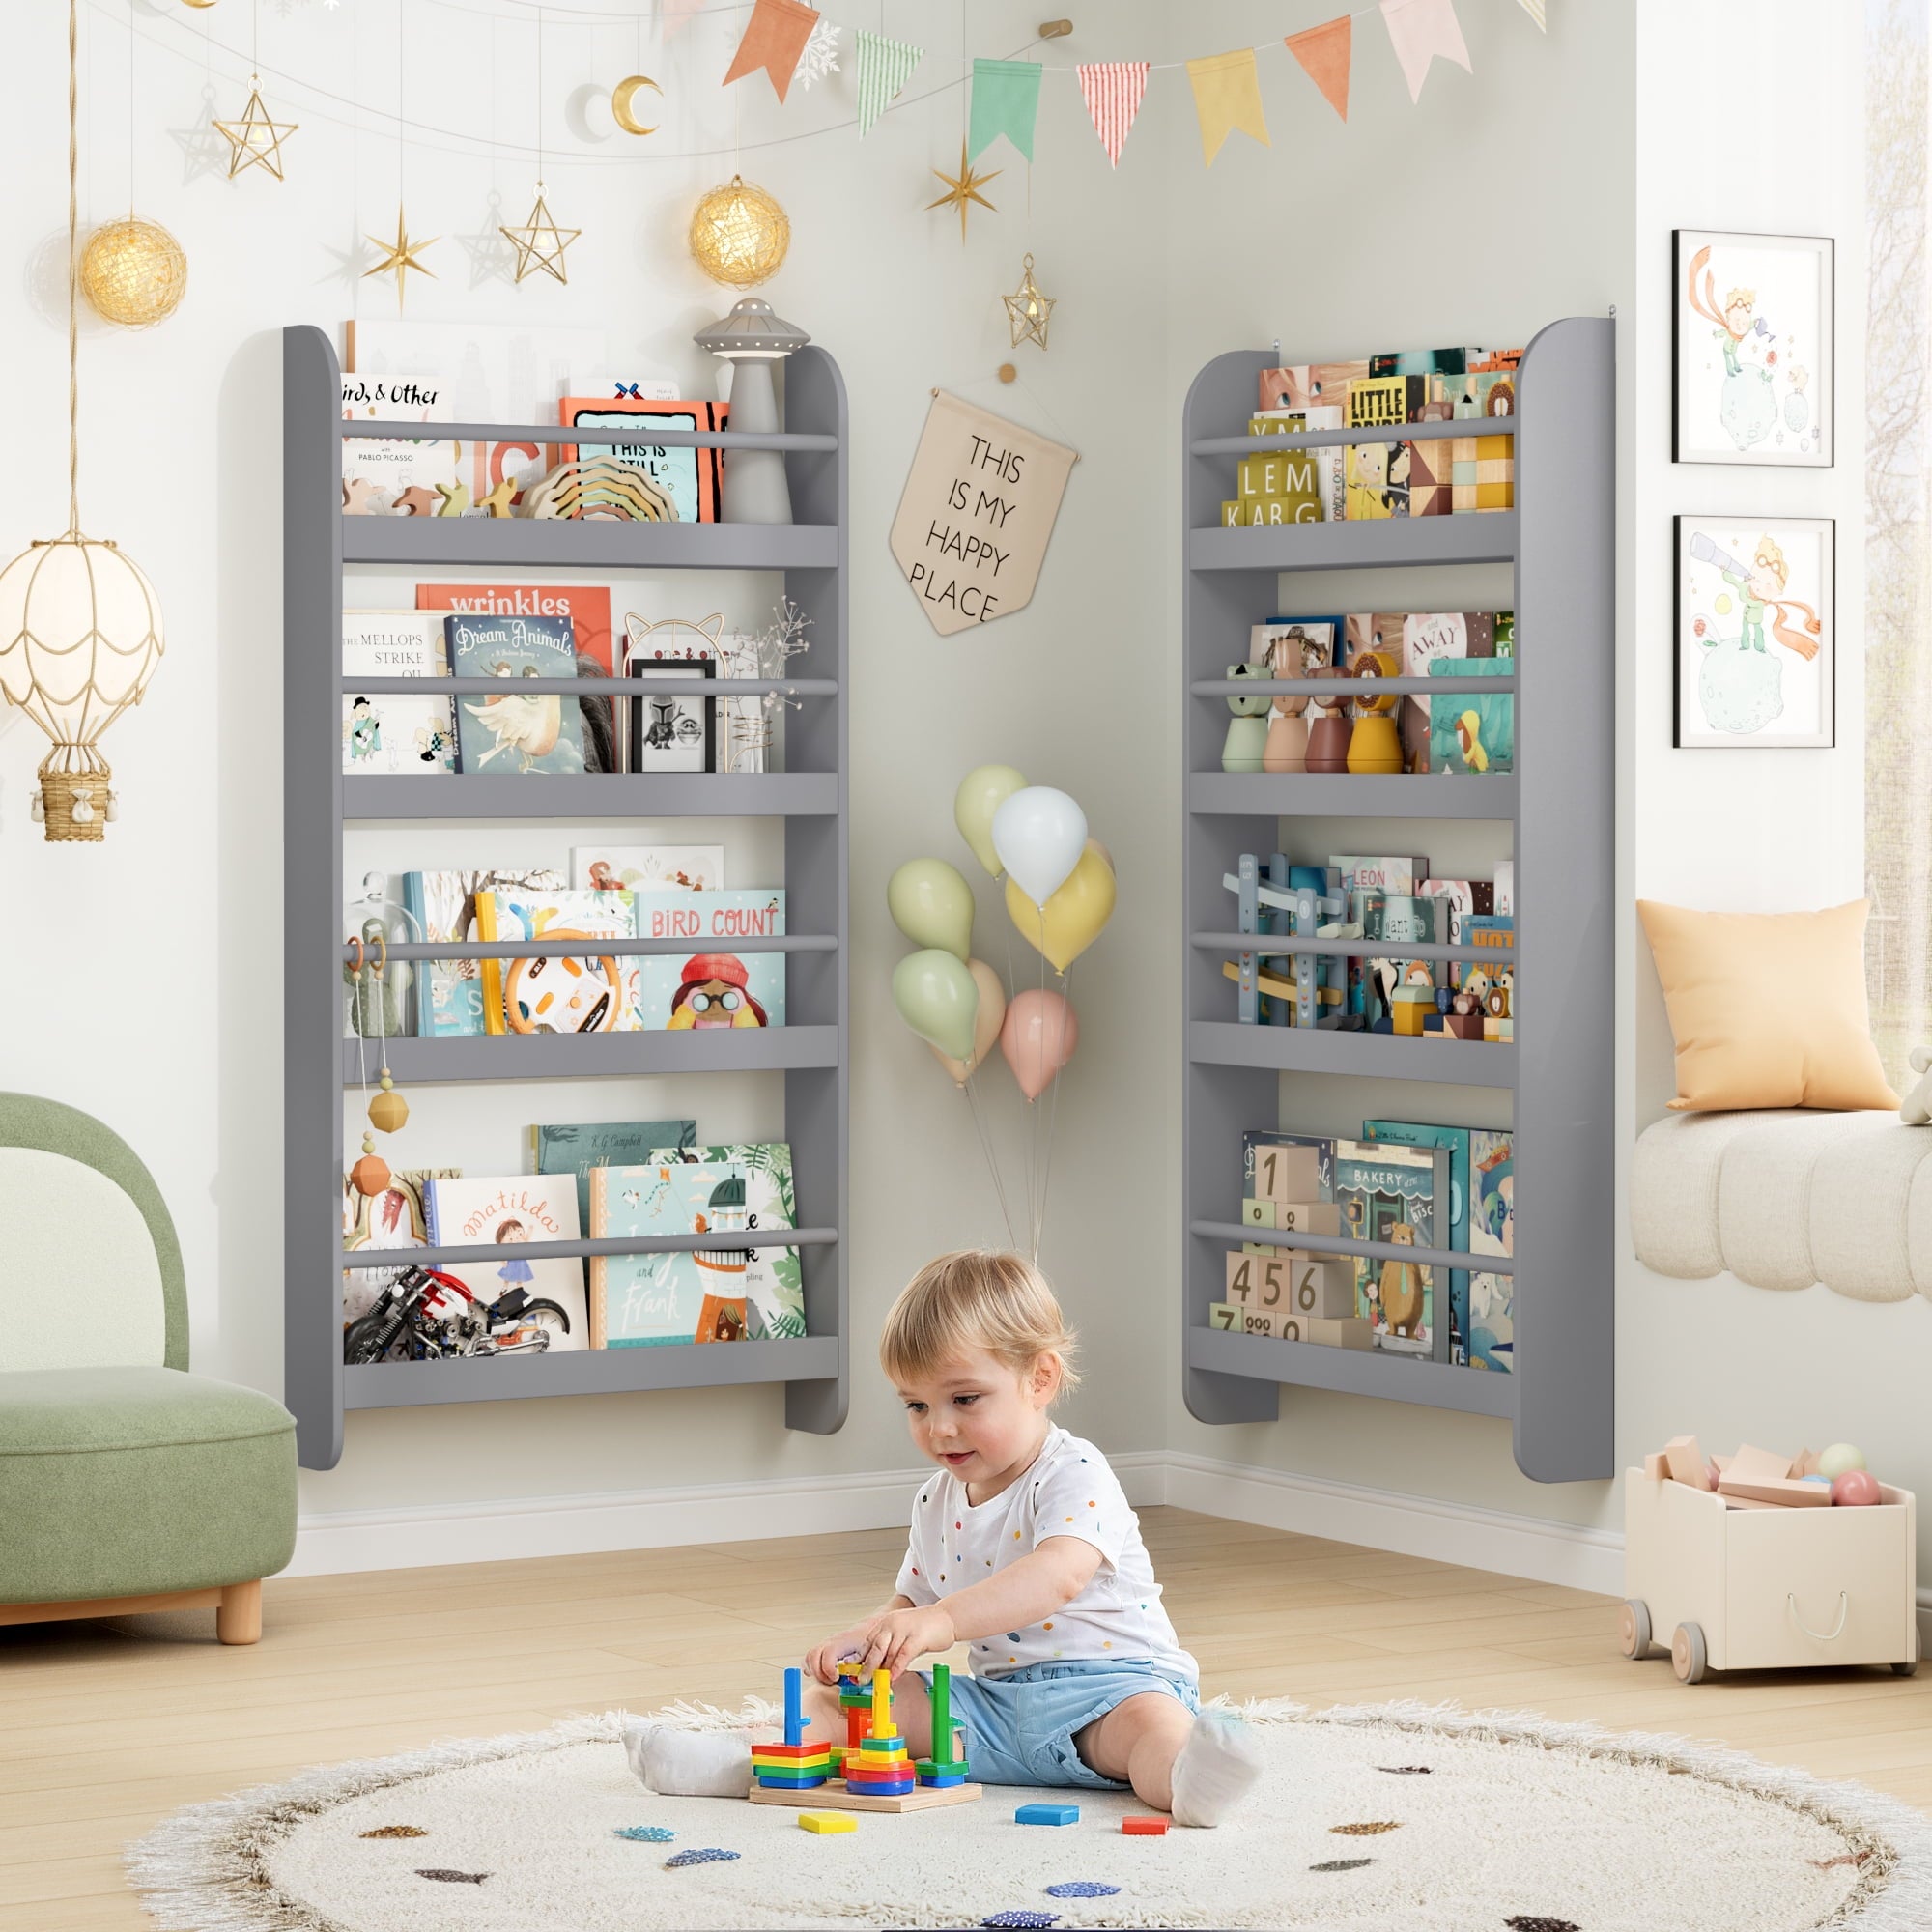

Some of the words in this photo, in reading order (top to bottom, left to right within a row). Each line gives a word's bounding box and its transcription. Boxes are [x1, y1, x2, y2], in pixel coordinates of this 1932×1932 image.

[342, 382, 371, 406] irds
[375, 384, 385, 401] &
[391, 384, 440, 406] Other
[1351, 388, 1403, 419] LITTLE
[971, 435, 1025, 484] THIS
[948, 478, 971, 510] IS
[975, 490, 1016, 528] MY
[925, 520, 1010, 577] HAPPY
[450, 589, 571, 616] wrinkles
[909, 562, 999, 622] PLACE
[360, 634, 423, 646] MELLOPS
[455, 623, 508, 656] Dream
[511, 619, 572, 657] Animals
[1412, 626, 1458, 661] AWAY
[375, 651, 424, 664] STRIKE
[1354, 869, 1385, 886] LEON
[712, 908, 779, 936] COUNT
[610, 1134, 642, 1150] Campbell
[1264, 1152, 1276, 1196] 1
[1354, 1169, 1403, 1187] BAKERY
[463, 1189, 559, 1237] Matilda
[637, 1264, 655, 1279] and
[746, 1273, 763, 1282] pling
[1232, 1259, 1251, 1302] 4
[1264, 1262, 1283, 1306] 5
[1298, 1267, 1316, 1311] 6
[621, 1275, 681, 1335] Frank
